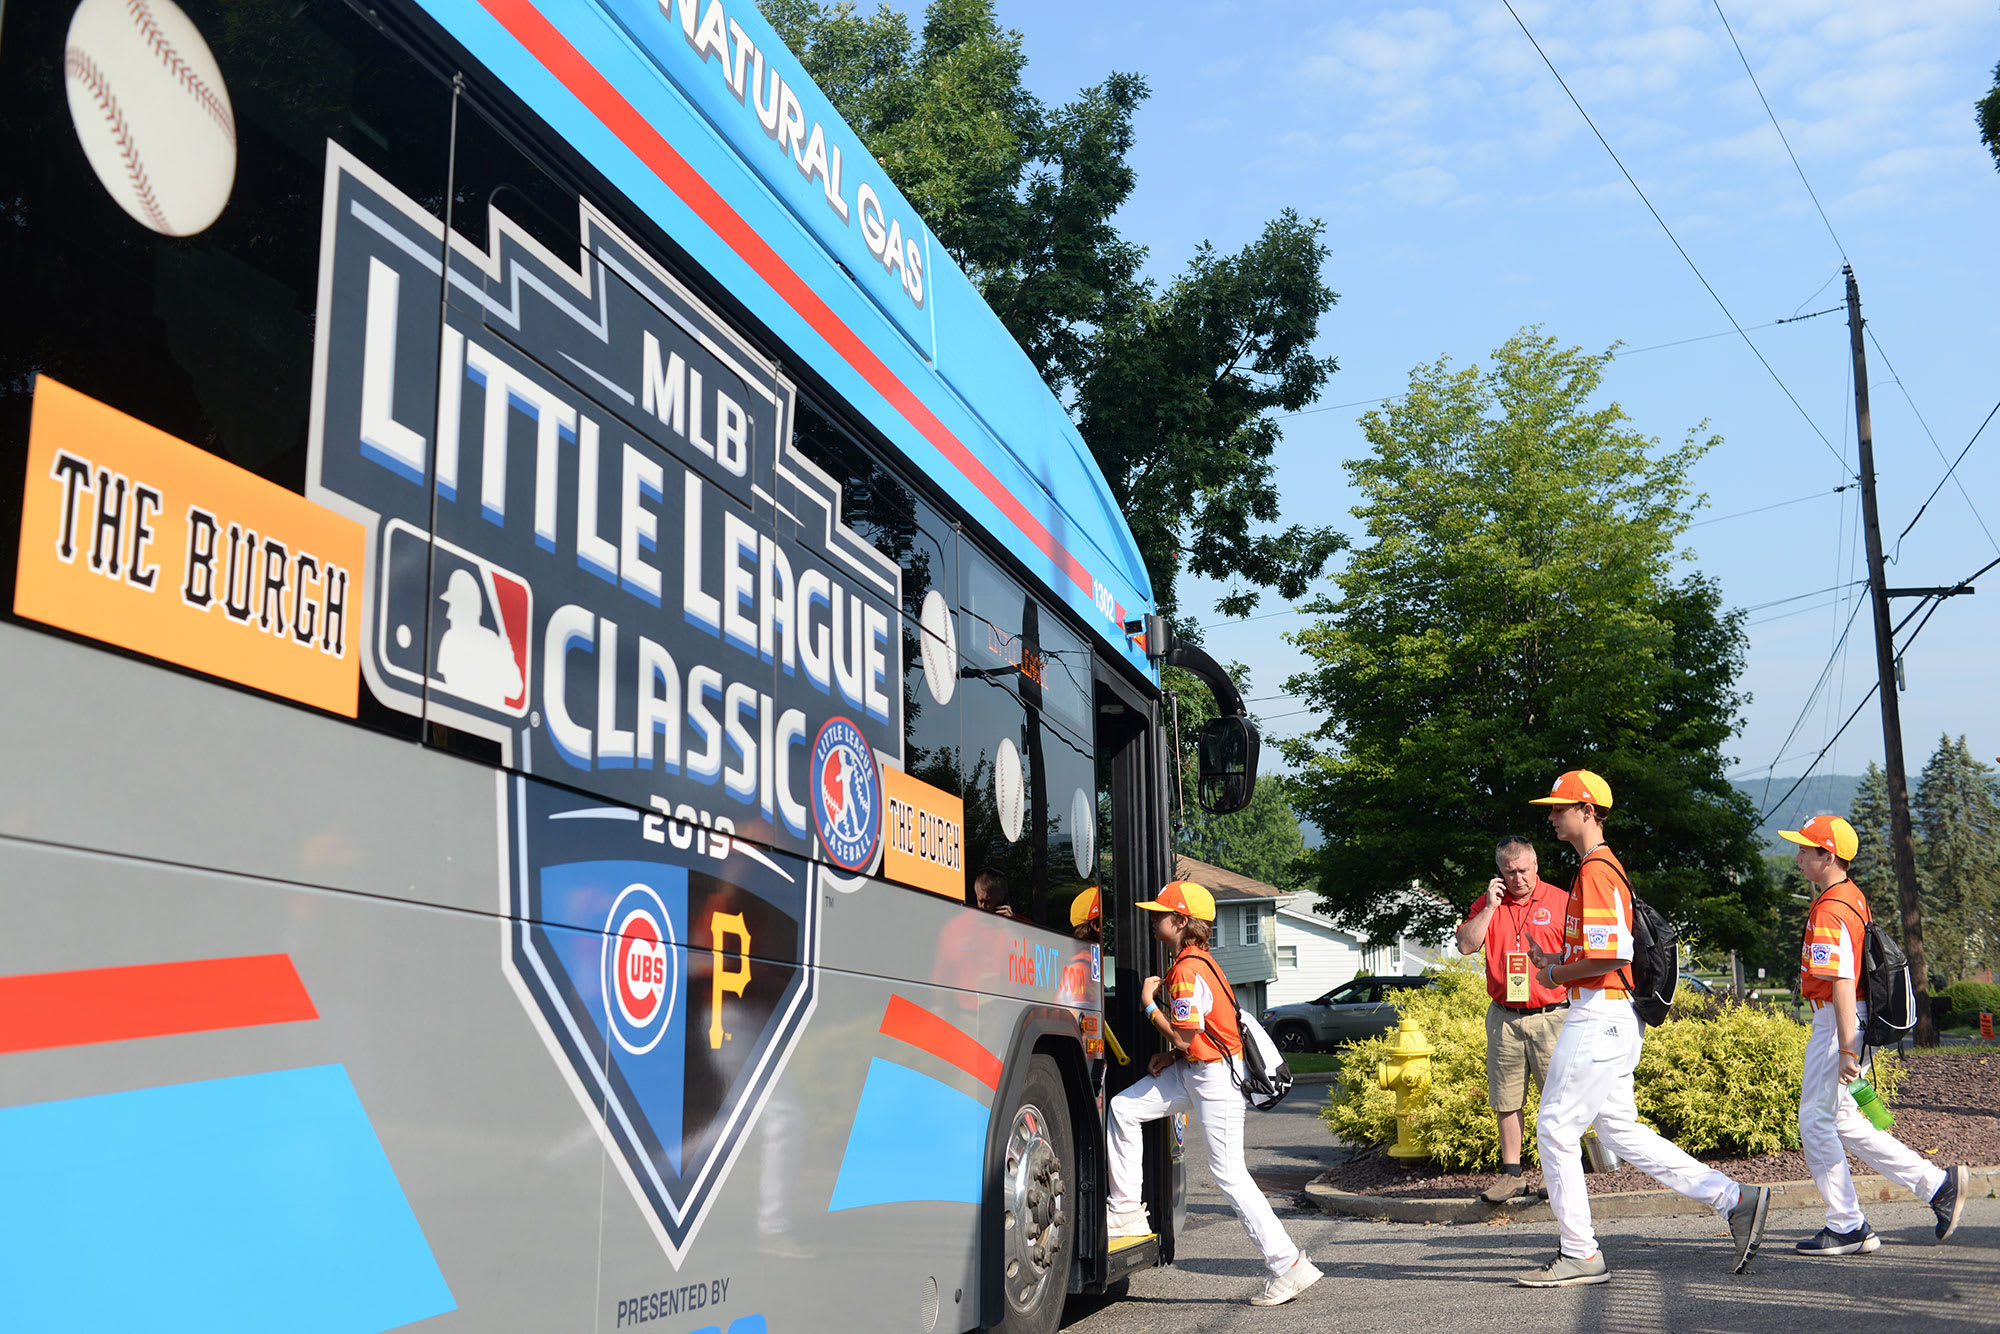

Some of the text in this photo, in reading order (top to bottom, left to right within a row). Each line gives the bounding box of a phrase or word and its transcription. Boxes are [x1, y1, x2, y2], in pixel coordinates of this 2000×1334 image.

[858, 182, 924, 310] GAS
[642, 329, 748, 478] MLB
[360, 255, 889, 726] LITTLE LEAGUE
[50, 448, 348, 659] THE BURGH
[1094, 578, 1115, 623] 1302
[543, 604, 806, 839] CLASSIC
[817, 725, 873, 781] LITTLE LEAGUE
[643, 794, 735, 860] 2019
[823, 821, 871, 862] BASEBALL
[889, 796, 961, 872] THE BURGH
[709, 911, 752, 1049] P
[1008, 937, 1086, 995] rideRVT.com
[617, 1282, 707, 1328] PRESENTED
[711, 1277, 730, 1306] BY
